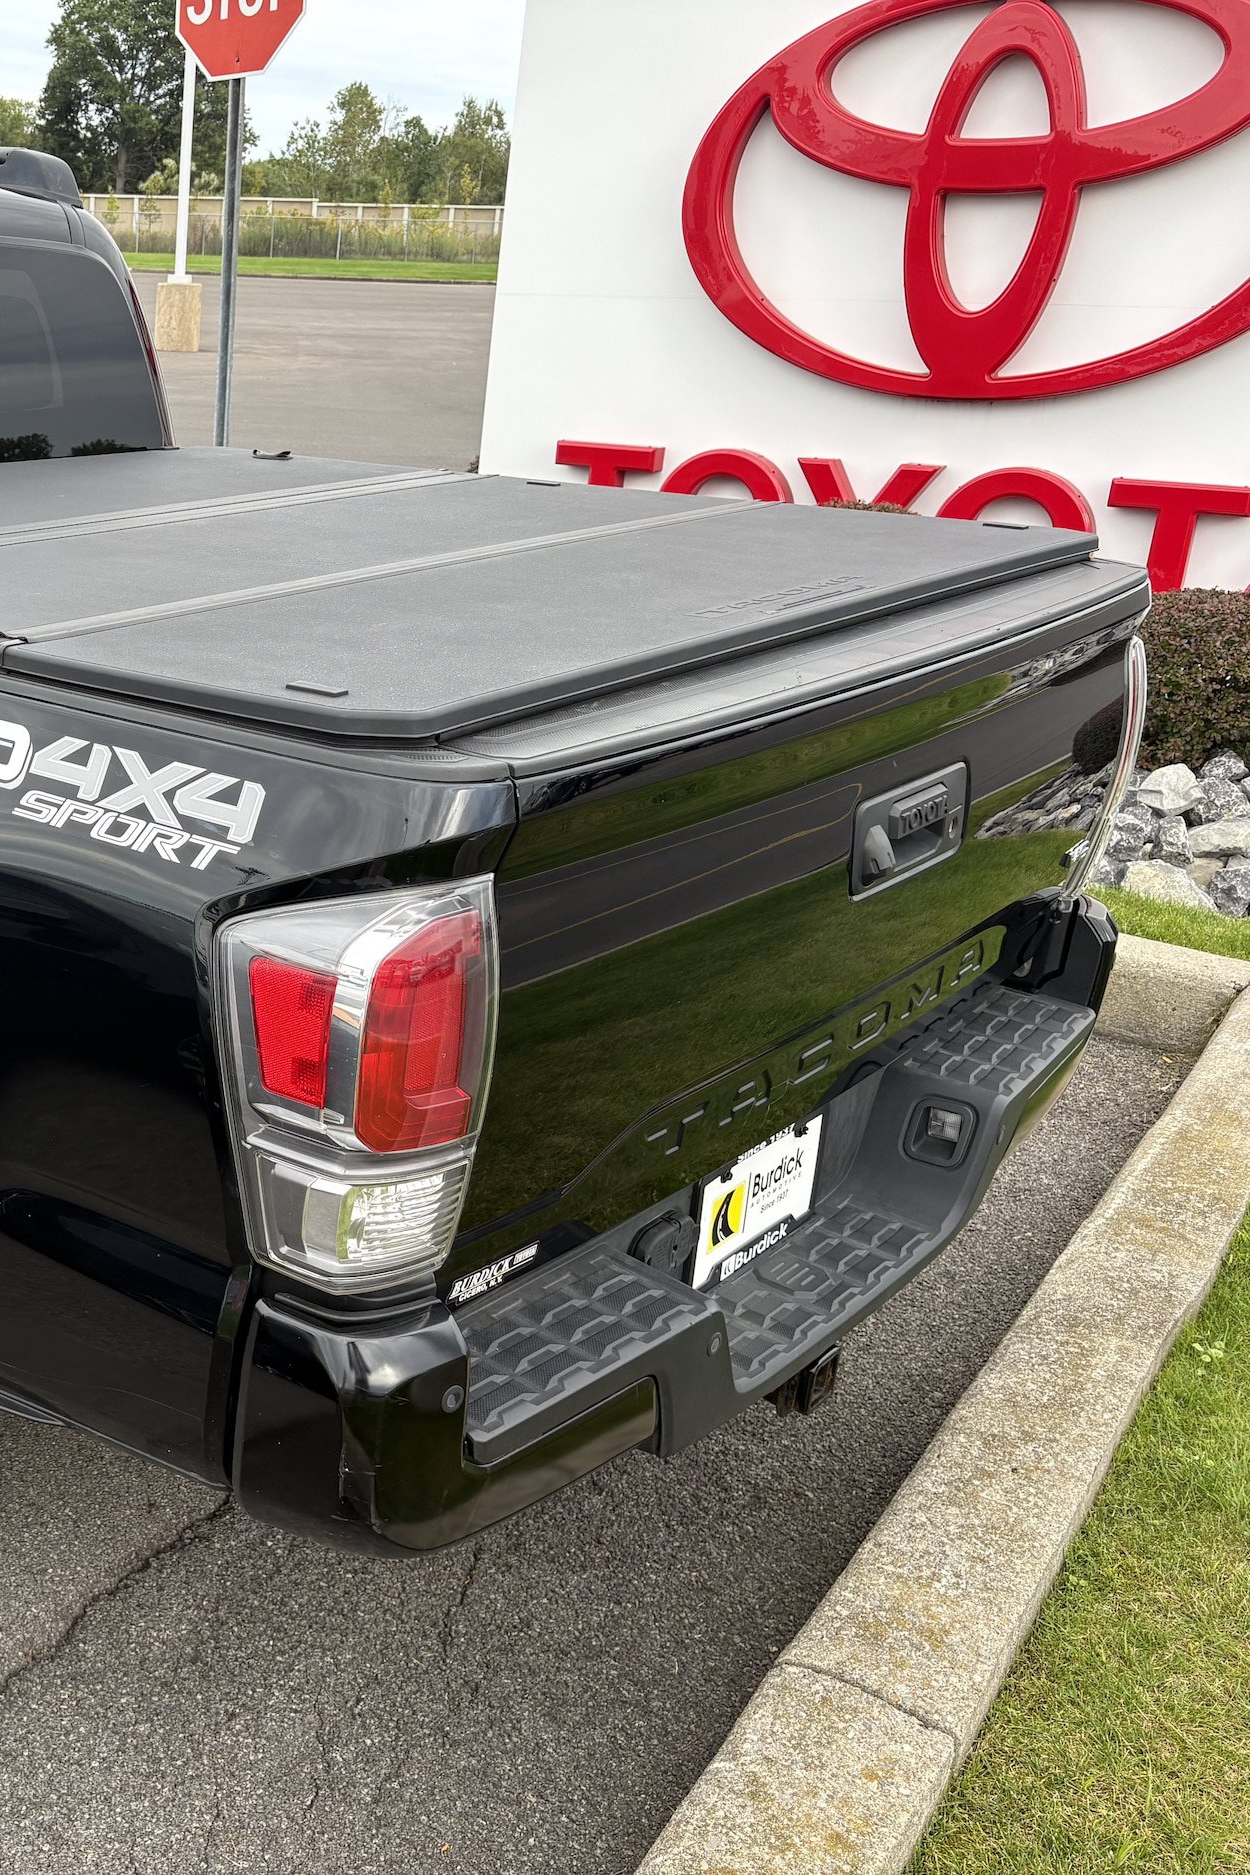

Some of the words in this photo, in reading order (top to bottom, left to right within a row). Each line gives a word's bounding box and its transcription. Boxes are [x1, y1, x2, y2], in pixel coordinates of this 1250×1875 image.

[555, 440, 1250, 593] TOYOT
[12, 790, 241, 871] SPORT
[646, 940, 985, 1156] TACOMA
[750, 1171, 802, 1209] AUTOMOTIVE
[752, 1147, 804, 1198] Burdick
[734, 1221, 789, 1269] Burdick
[450, 1256, 514, 1298] BURDICK
